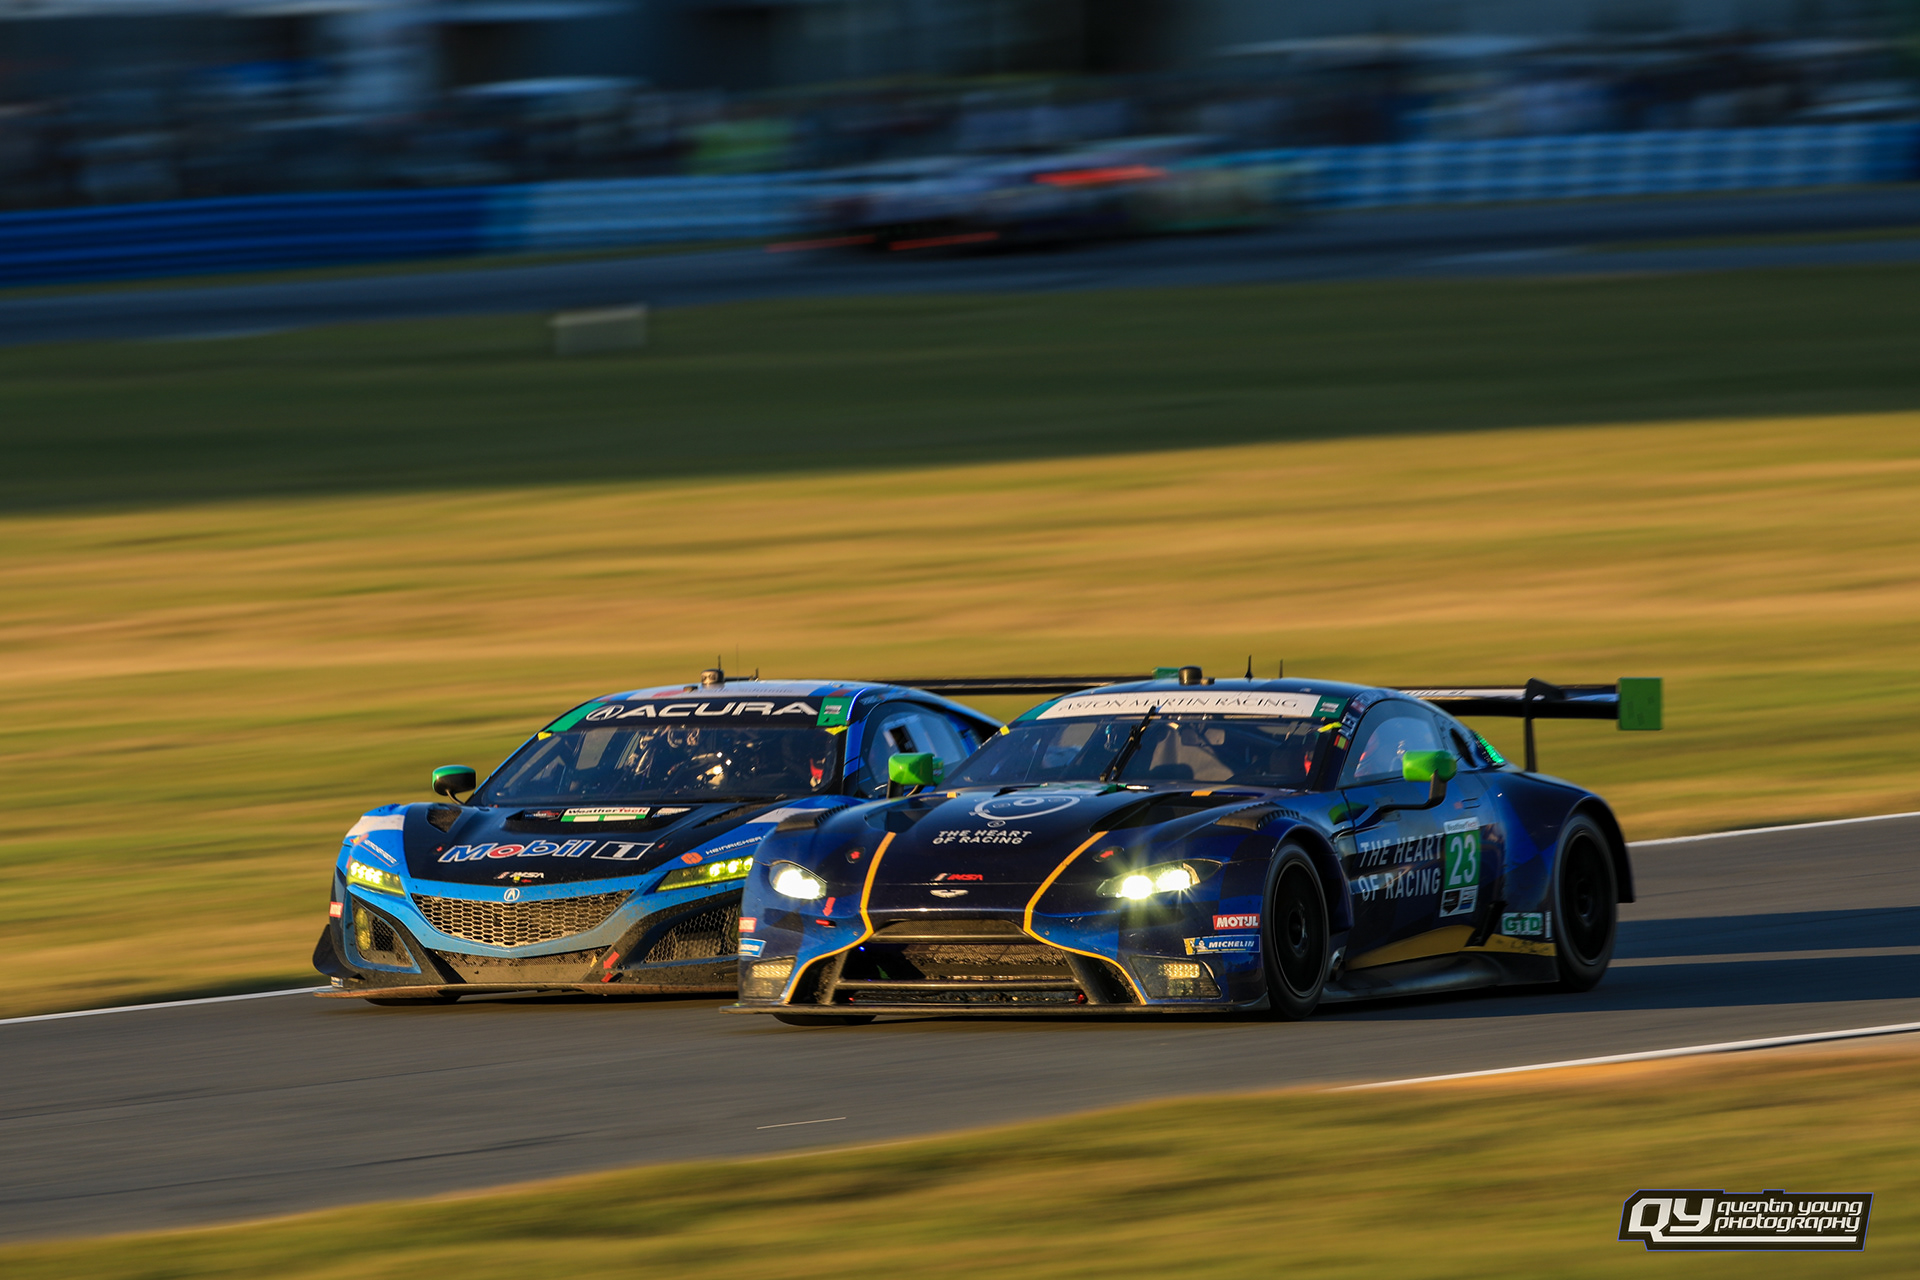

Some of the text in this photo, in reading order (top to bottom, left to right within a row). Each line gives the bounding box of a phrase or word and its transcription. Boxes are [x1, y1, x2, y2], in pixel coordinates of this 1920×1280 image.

[617, 701, 818, 719] ACURA
[1058, 697, 1298, 712] ASTON MARTIN RACING
[932, 836, 1023, 845] OF RACING
[938, 829, 1032, 838] THE HEART
[437, 840, 596, 863] Mobil
[1360, 832, 1445, 868] THE HEART
[1448, 834, 1477, 887] 23
[1358, 874, 1379, 901] OF
[1384, 867, 1441, 900] RACING
[1216, 915, 1259, 928] MOTUL
[1505, 916, 1541, 931] GTD
[1208, 940, 1255, 948] MICHELIN
